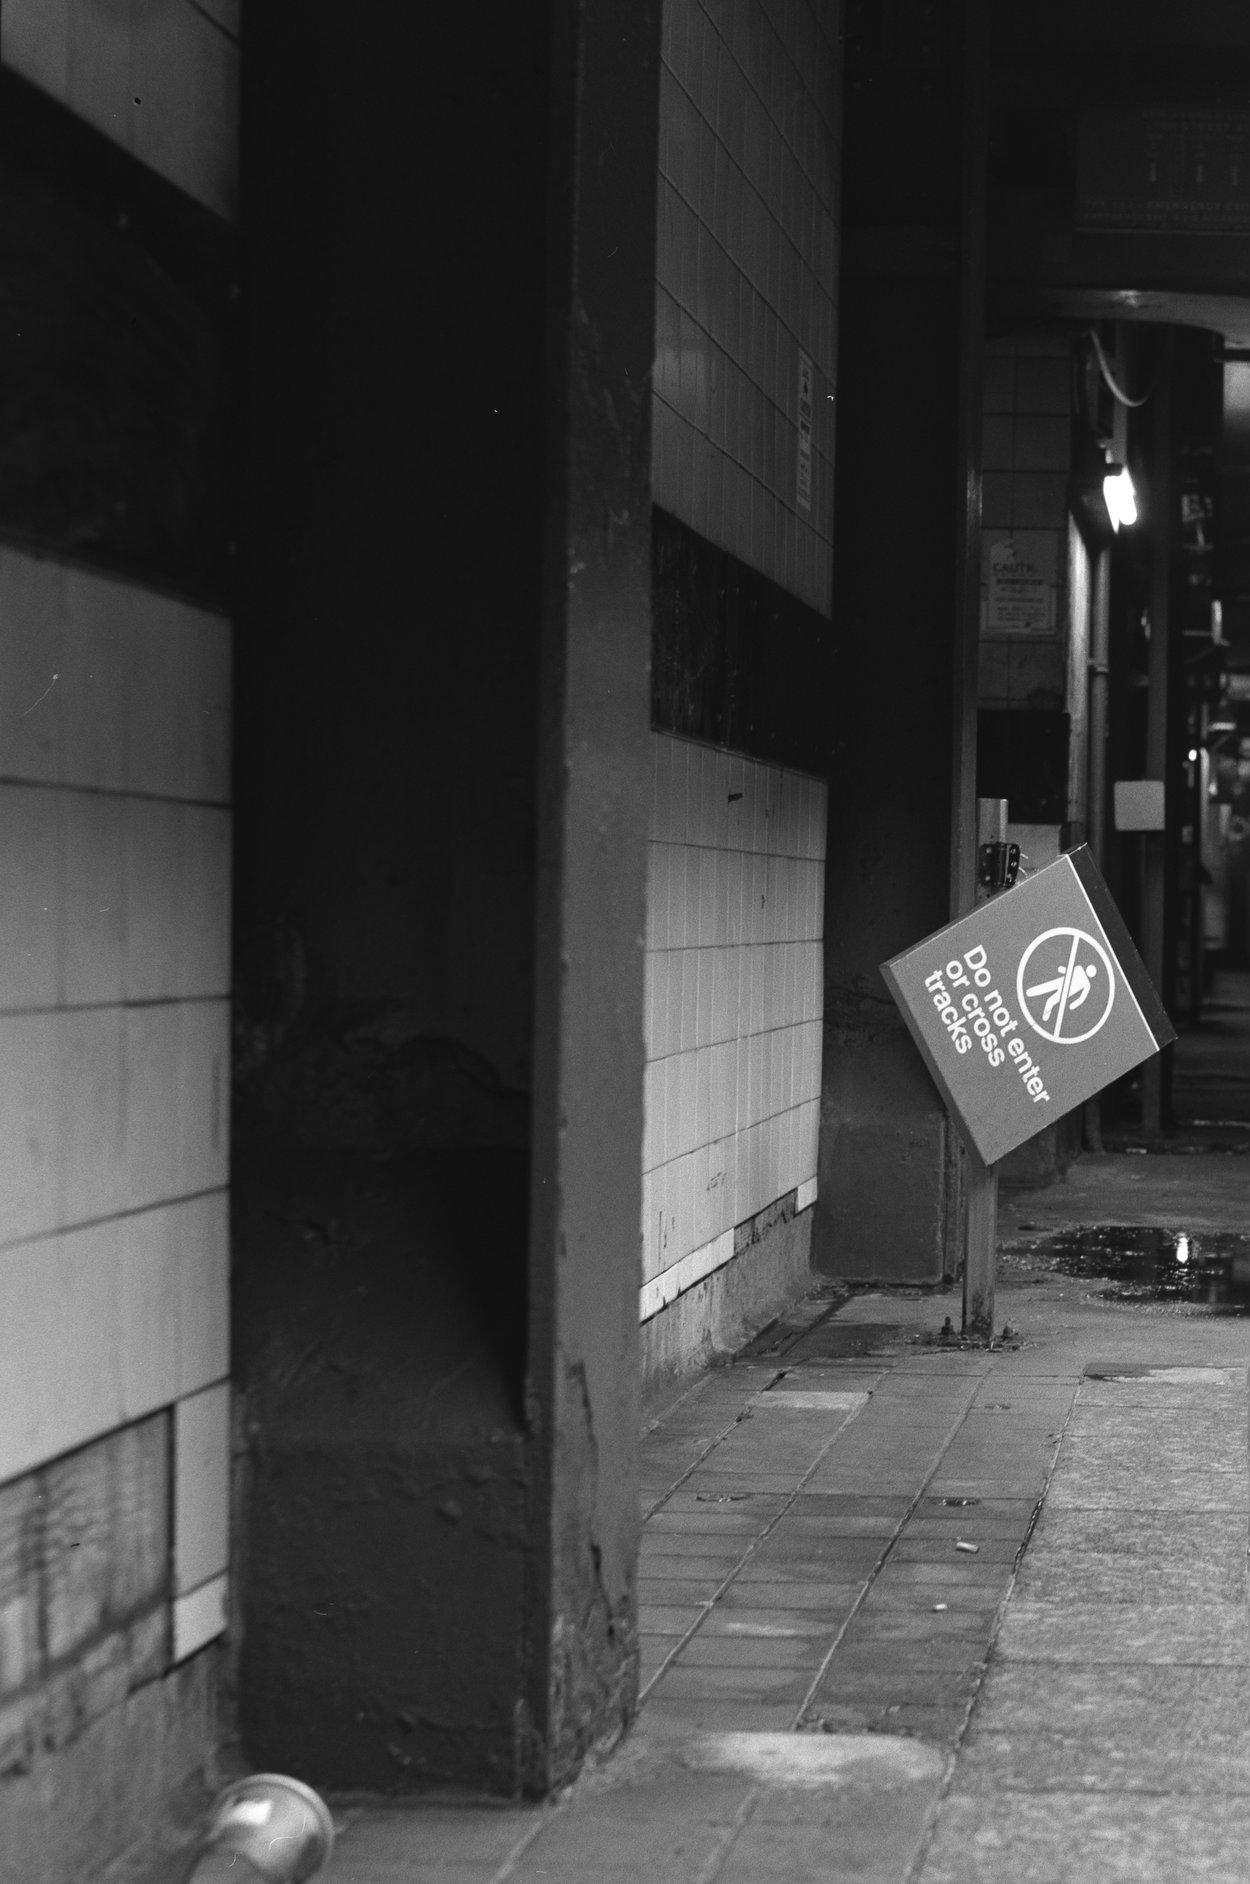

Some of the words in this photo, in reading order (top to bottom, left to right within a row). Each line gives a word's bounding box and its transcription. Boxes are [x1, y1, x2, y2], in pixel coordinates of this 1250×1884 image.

[924, 969, 973, 1055] tracks
[945, 959, 971, 989] or
[961, 992, 1006, 1068] cross
[962, 944, 992, 988] Do
[983, 987, 1019, 1038] not
[1006, 1037, 1051, 1104] enter
